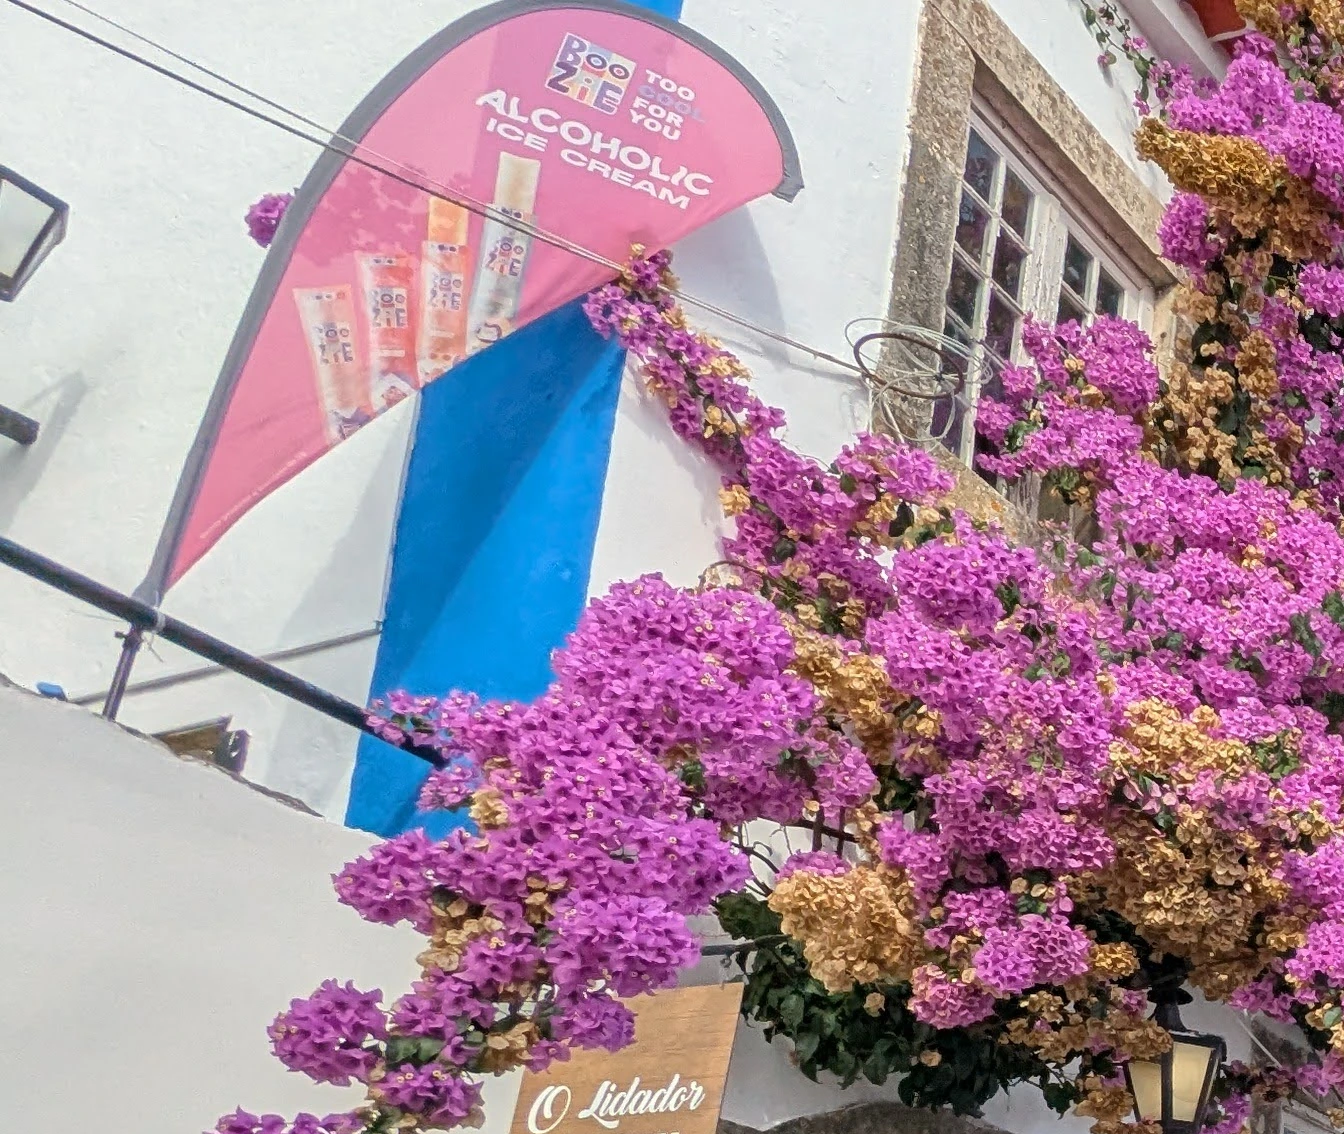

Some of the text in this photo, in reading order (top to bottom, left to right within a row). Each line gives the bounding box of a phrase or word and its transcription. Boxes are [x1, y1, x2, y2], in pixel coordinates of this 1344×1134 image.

[637, 85, 705, 123] COOL
[645, 69, 696, 101] TOO
[630, 109, 682, 141] YOU
[633, 96, 685, 129] FOR
[476, 89, 714, 196] ALCOHOLIC
[486, 118, 692, 210] ICE CREAM
[527, 1073, 705, 1134] O Lidador
